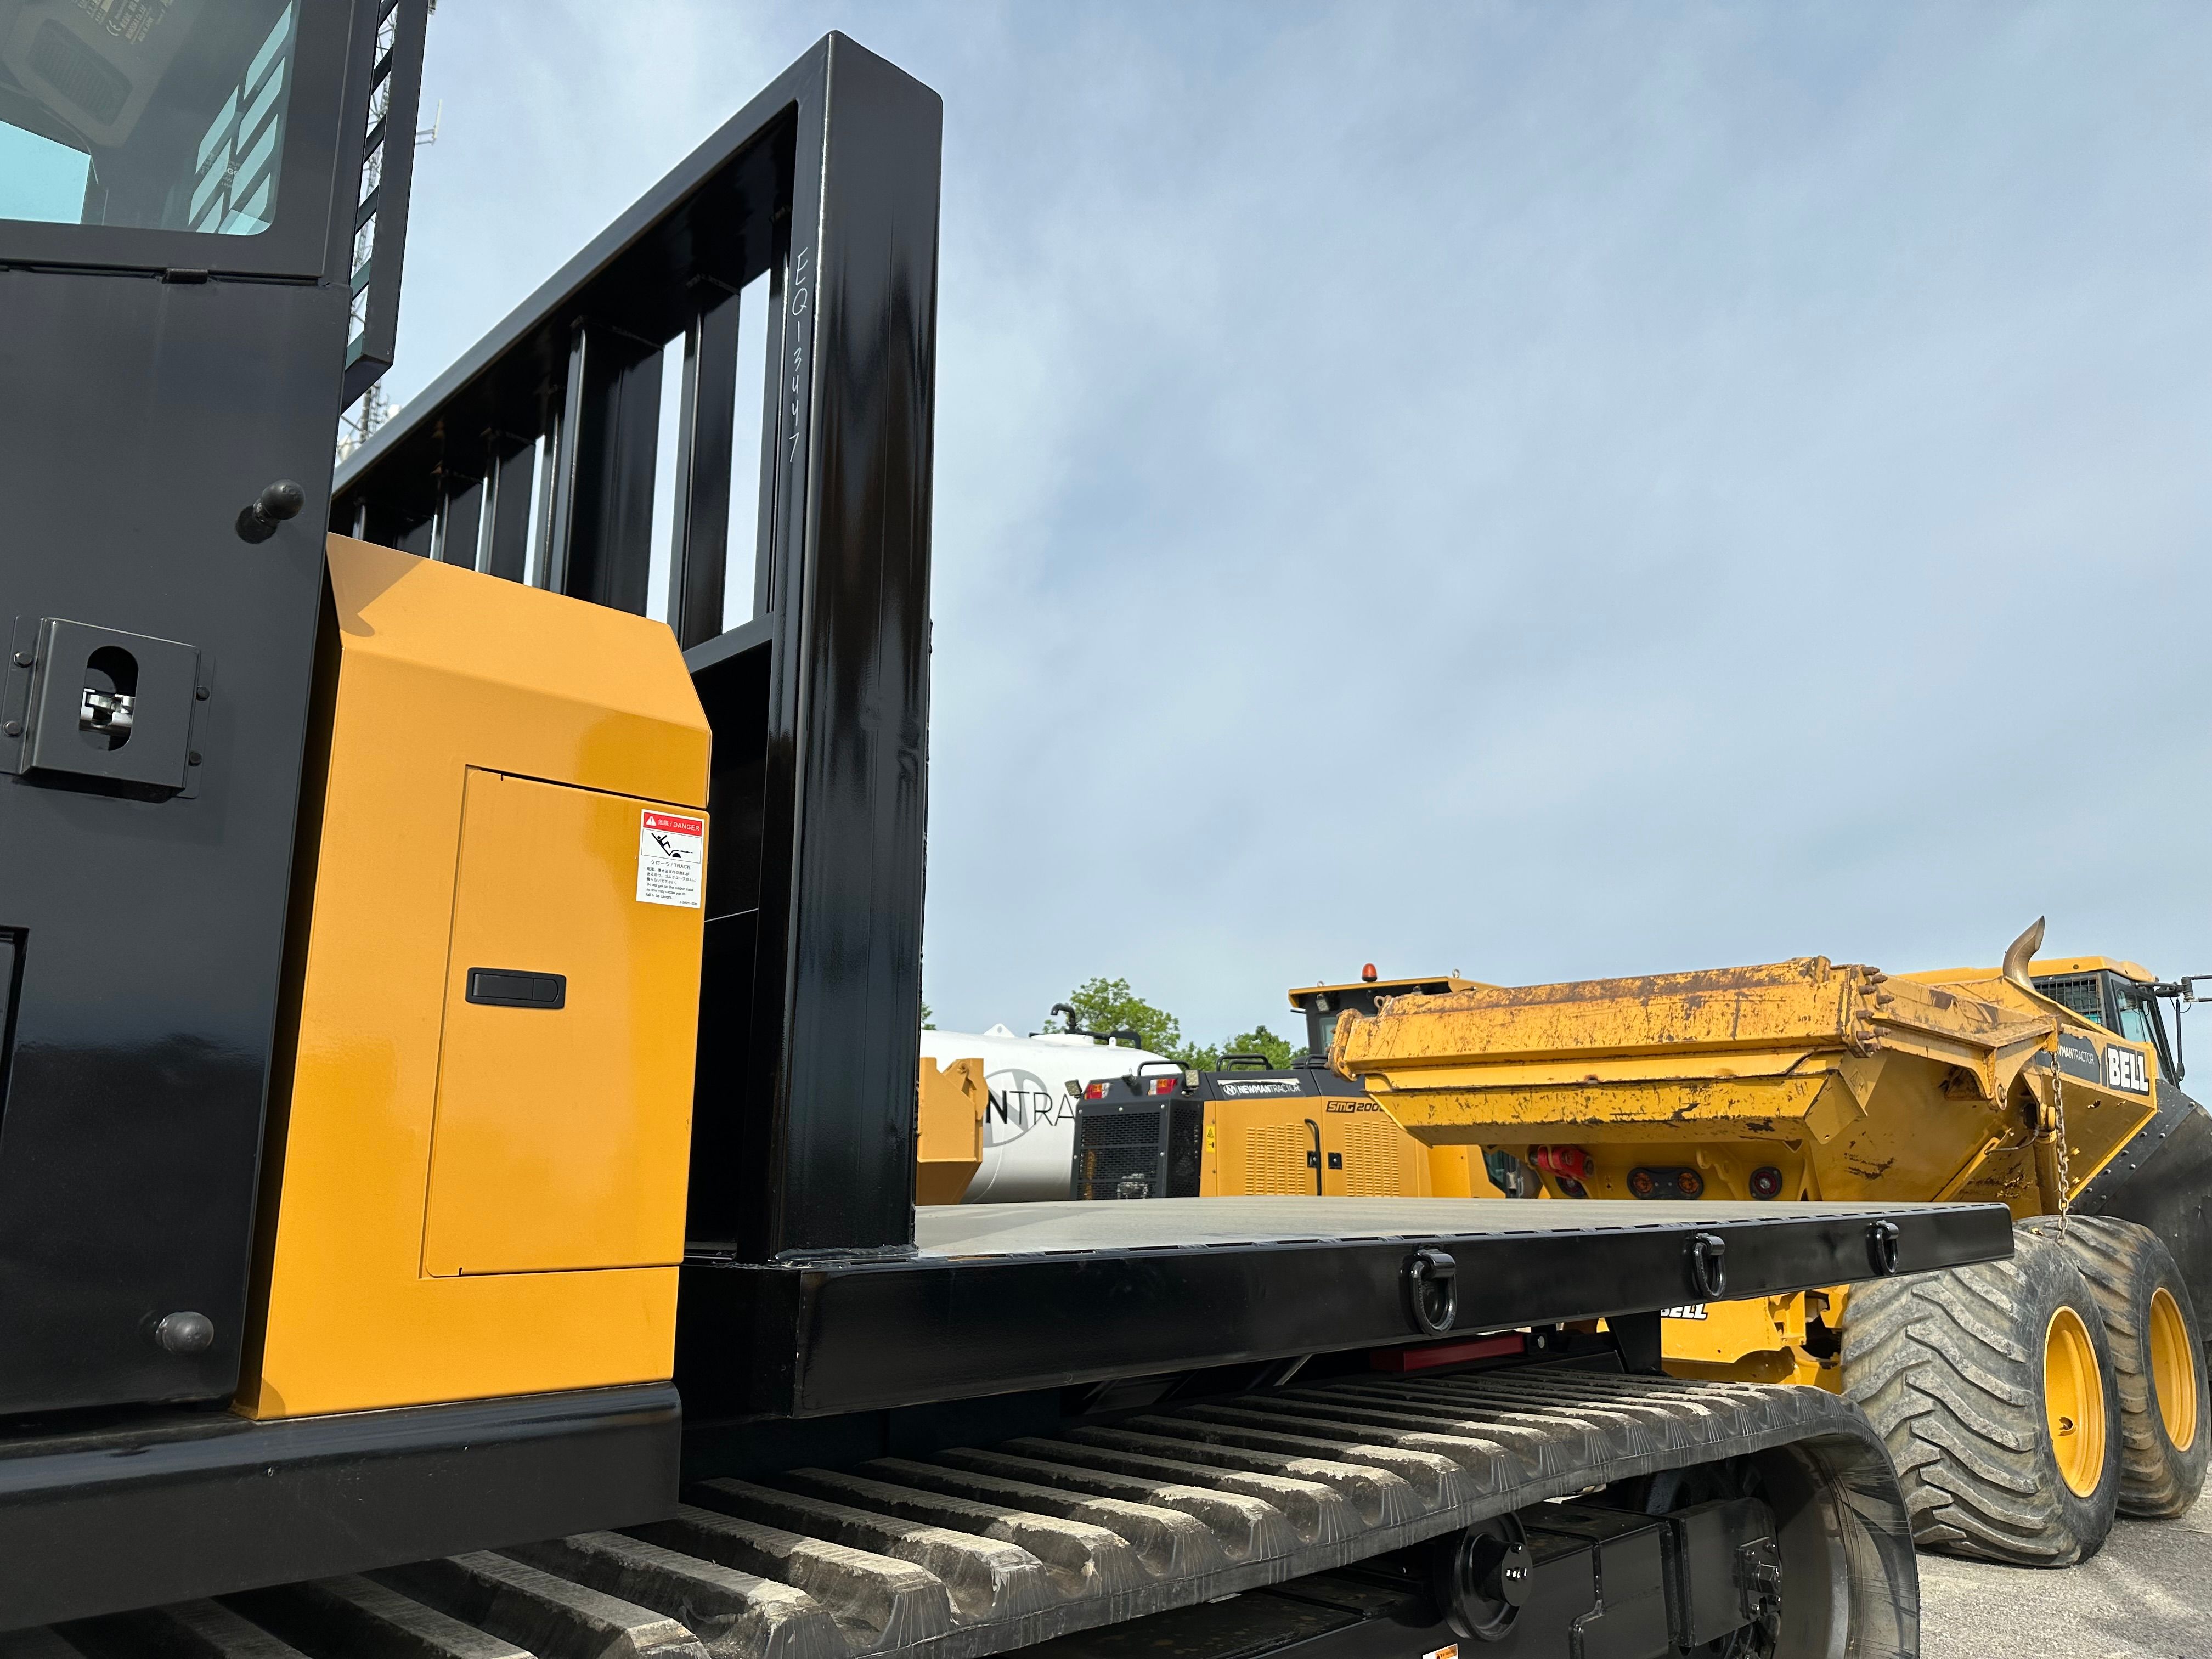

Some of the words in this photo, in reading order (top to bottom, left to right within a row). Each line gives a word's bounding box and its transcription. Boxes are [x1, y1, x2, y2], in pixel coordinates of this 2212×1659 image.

[789, 247, 809, 462] EQ13447
[673, 822, 700, 832] DANGER
[2107, 1047, 2149, 1092] BELL
[1237, 1084, 1301, 1094] NEWMANTRACTOR
[1327, 1101, 1355, 1112] SMG
[1356, 1103, 1385, 1111] 200
